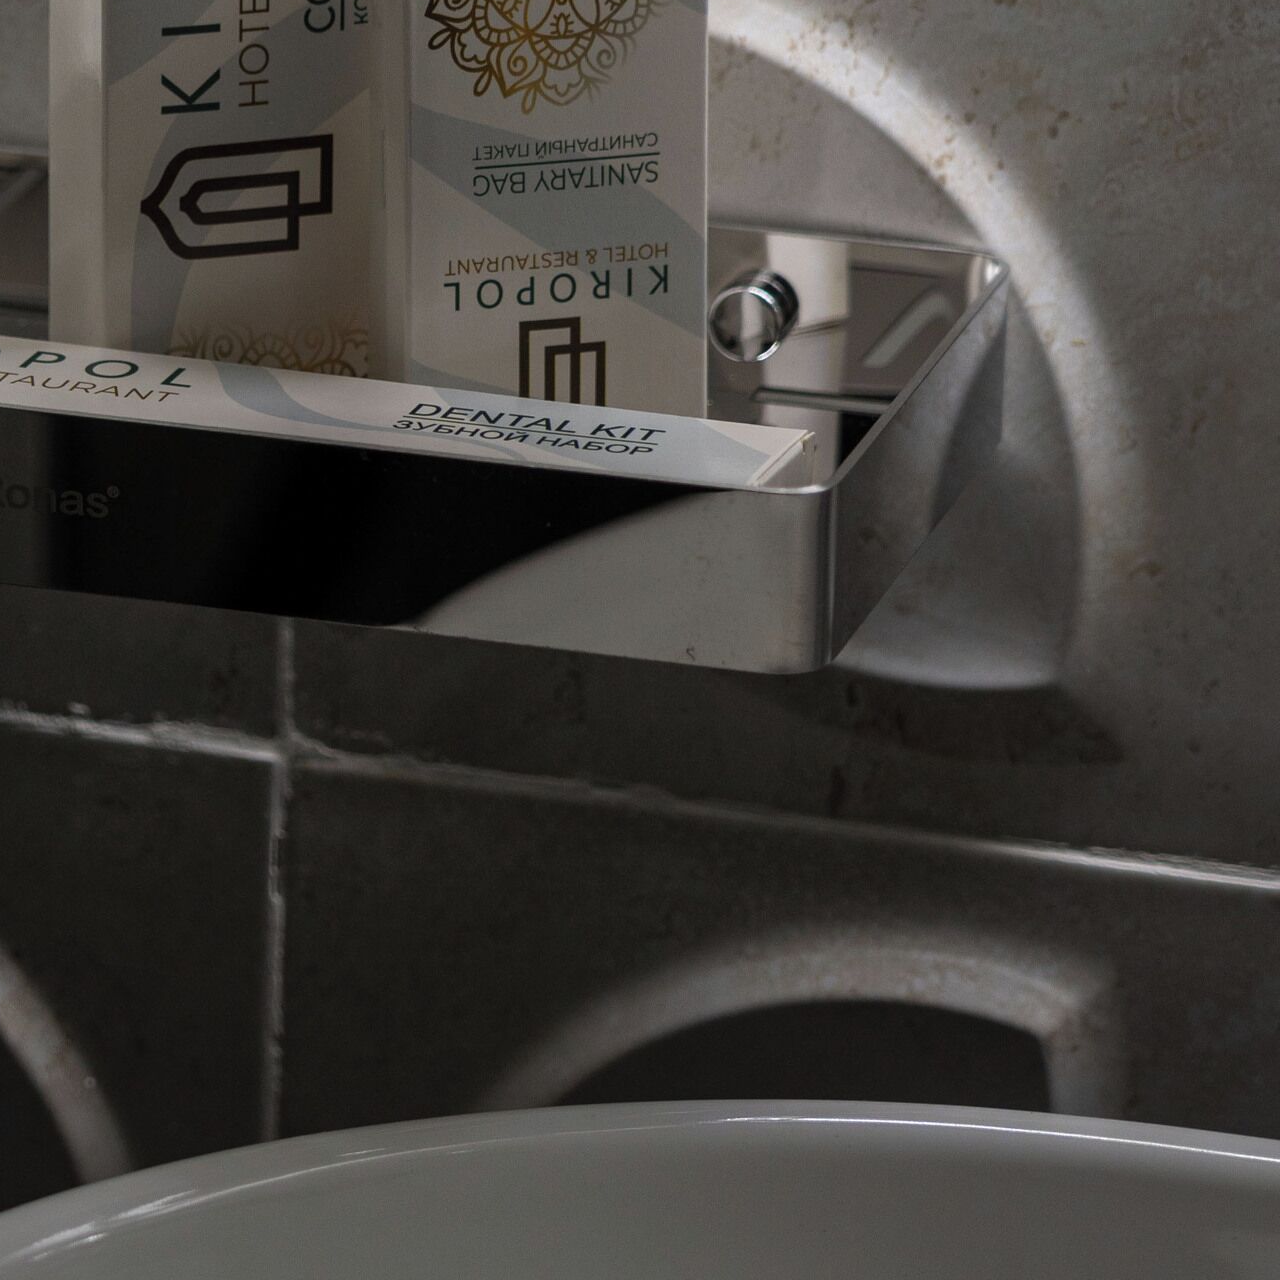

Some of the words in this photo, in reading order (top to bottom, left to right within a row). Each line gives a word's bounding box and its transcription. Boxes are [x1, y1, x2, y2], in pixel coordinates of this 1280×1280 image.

[472, 143, 529, 161] ПАКЕТ
[535, 132, 659, 159] САНИТРАНЫЙ
[473, 172, 526, 197] BAG
[534, 160, 659, 192] SANITARY
[445, 250, 578, 276] RESTAURANT
[585, 248, 597, 264] &
[602, 242, 668, 263] HOTEL
[444, 264, 669, 311] KIROPOL
[408, 403, 576, 433] DENTAL
[590, 423, 666, 441] KIT
[393, 419, 529, 443] ЗУБНОЙ
[536, 435, 654, 455] НАБОР
